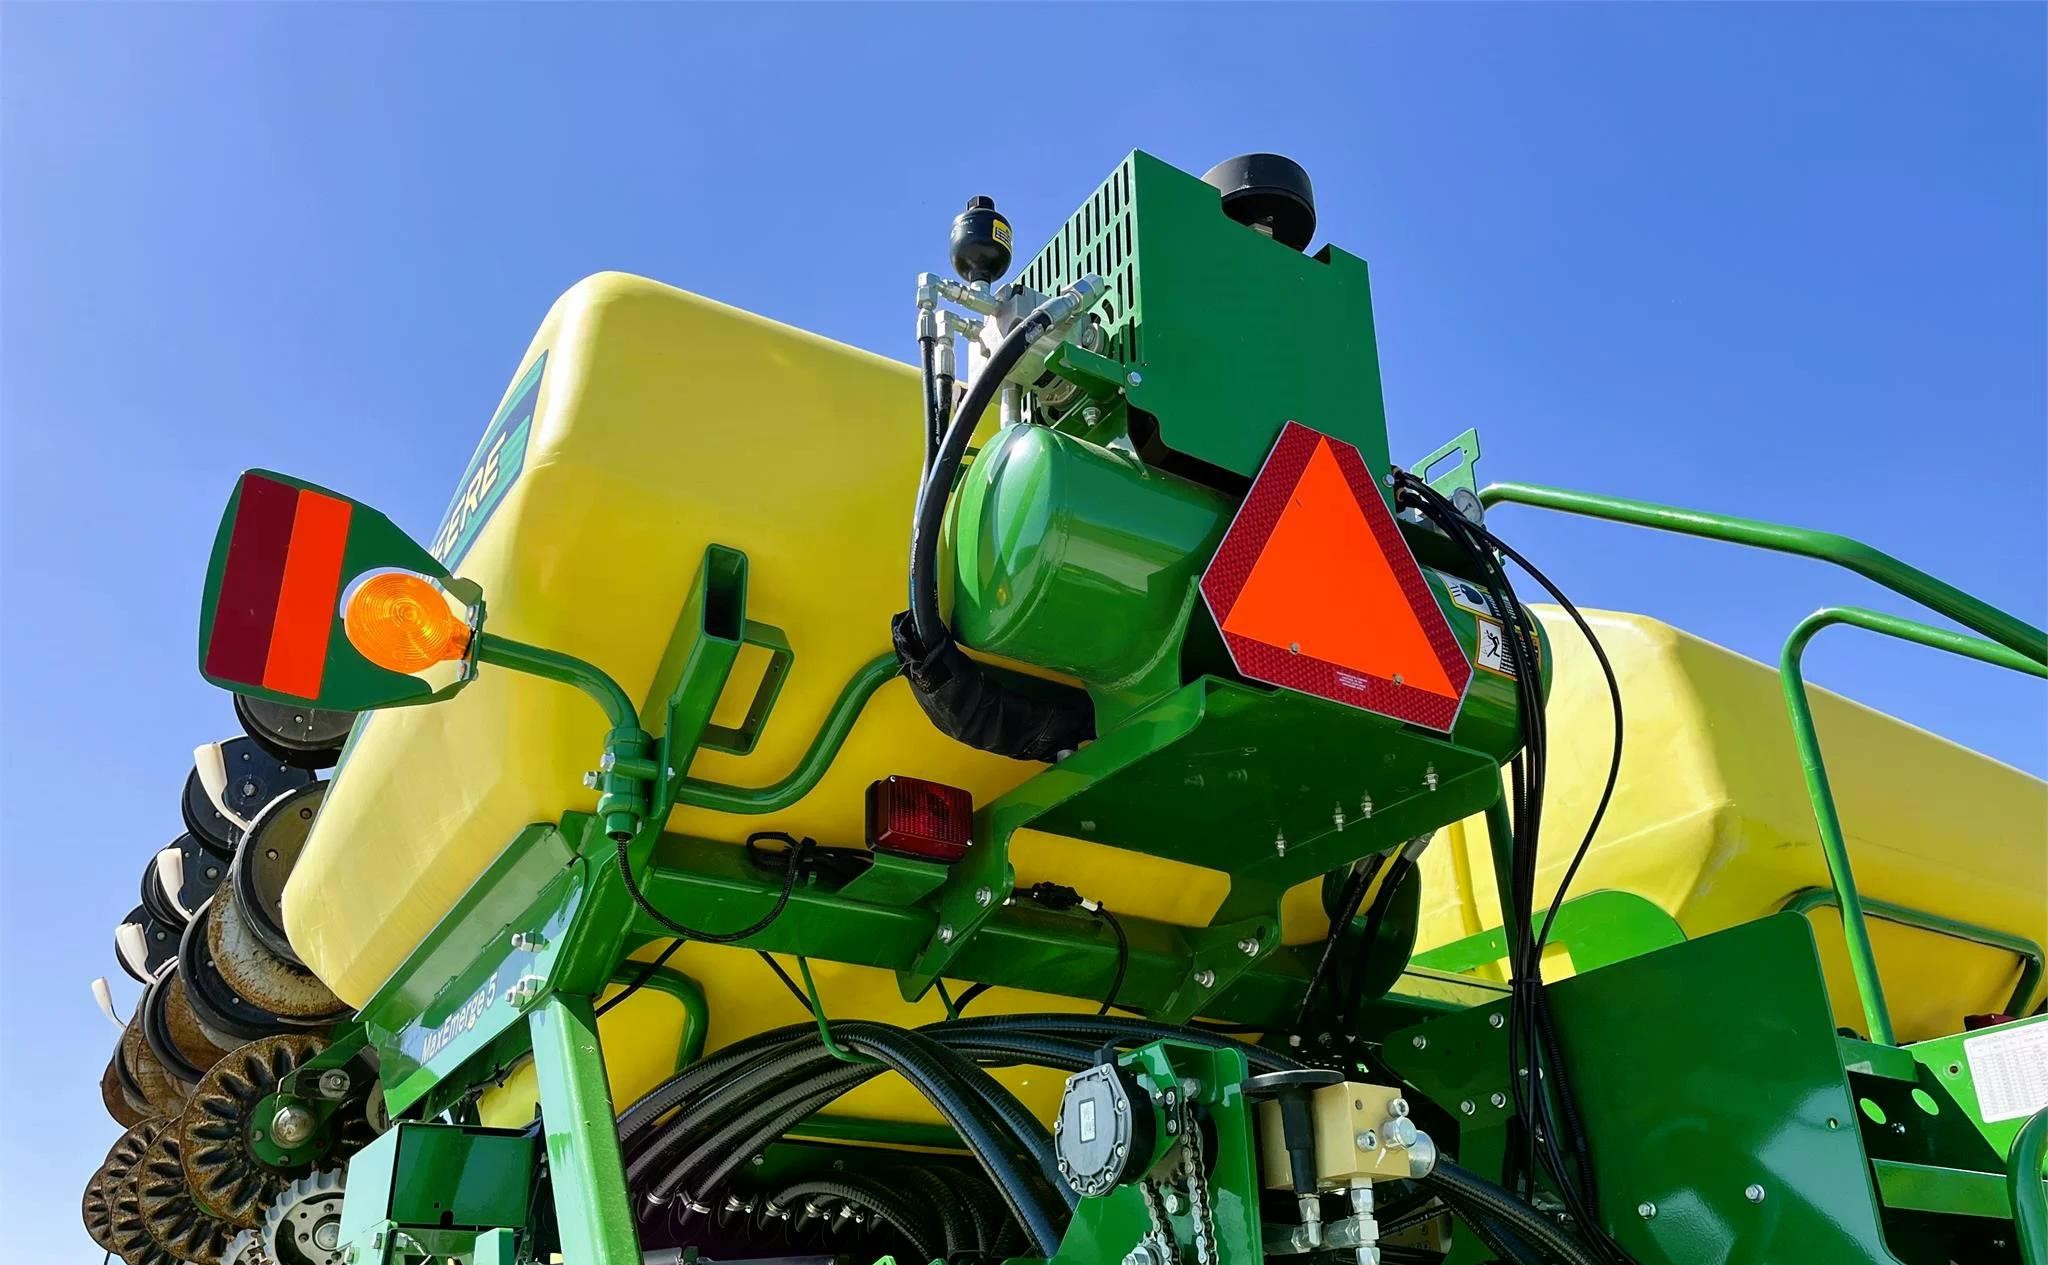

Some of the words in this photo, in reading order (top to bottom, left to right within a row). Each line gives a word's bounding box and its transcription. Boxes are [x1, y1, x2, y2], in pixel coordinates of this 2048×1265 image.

[431, 431, 506, 562] EERE
[421, 990, 485, 1065] MaxEmerge
[487, 971, 499, 1007] 5
